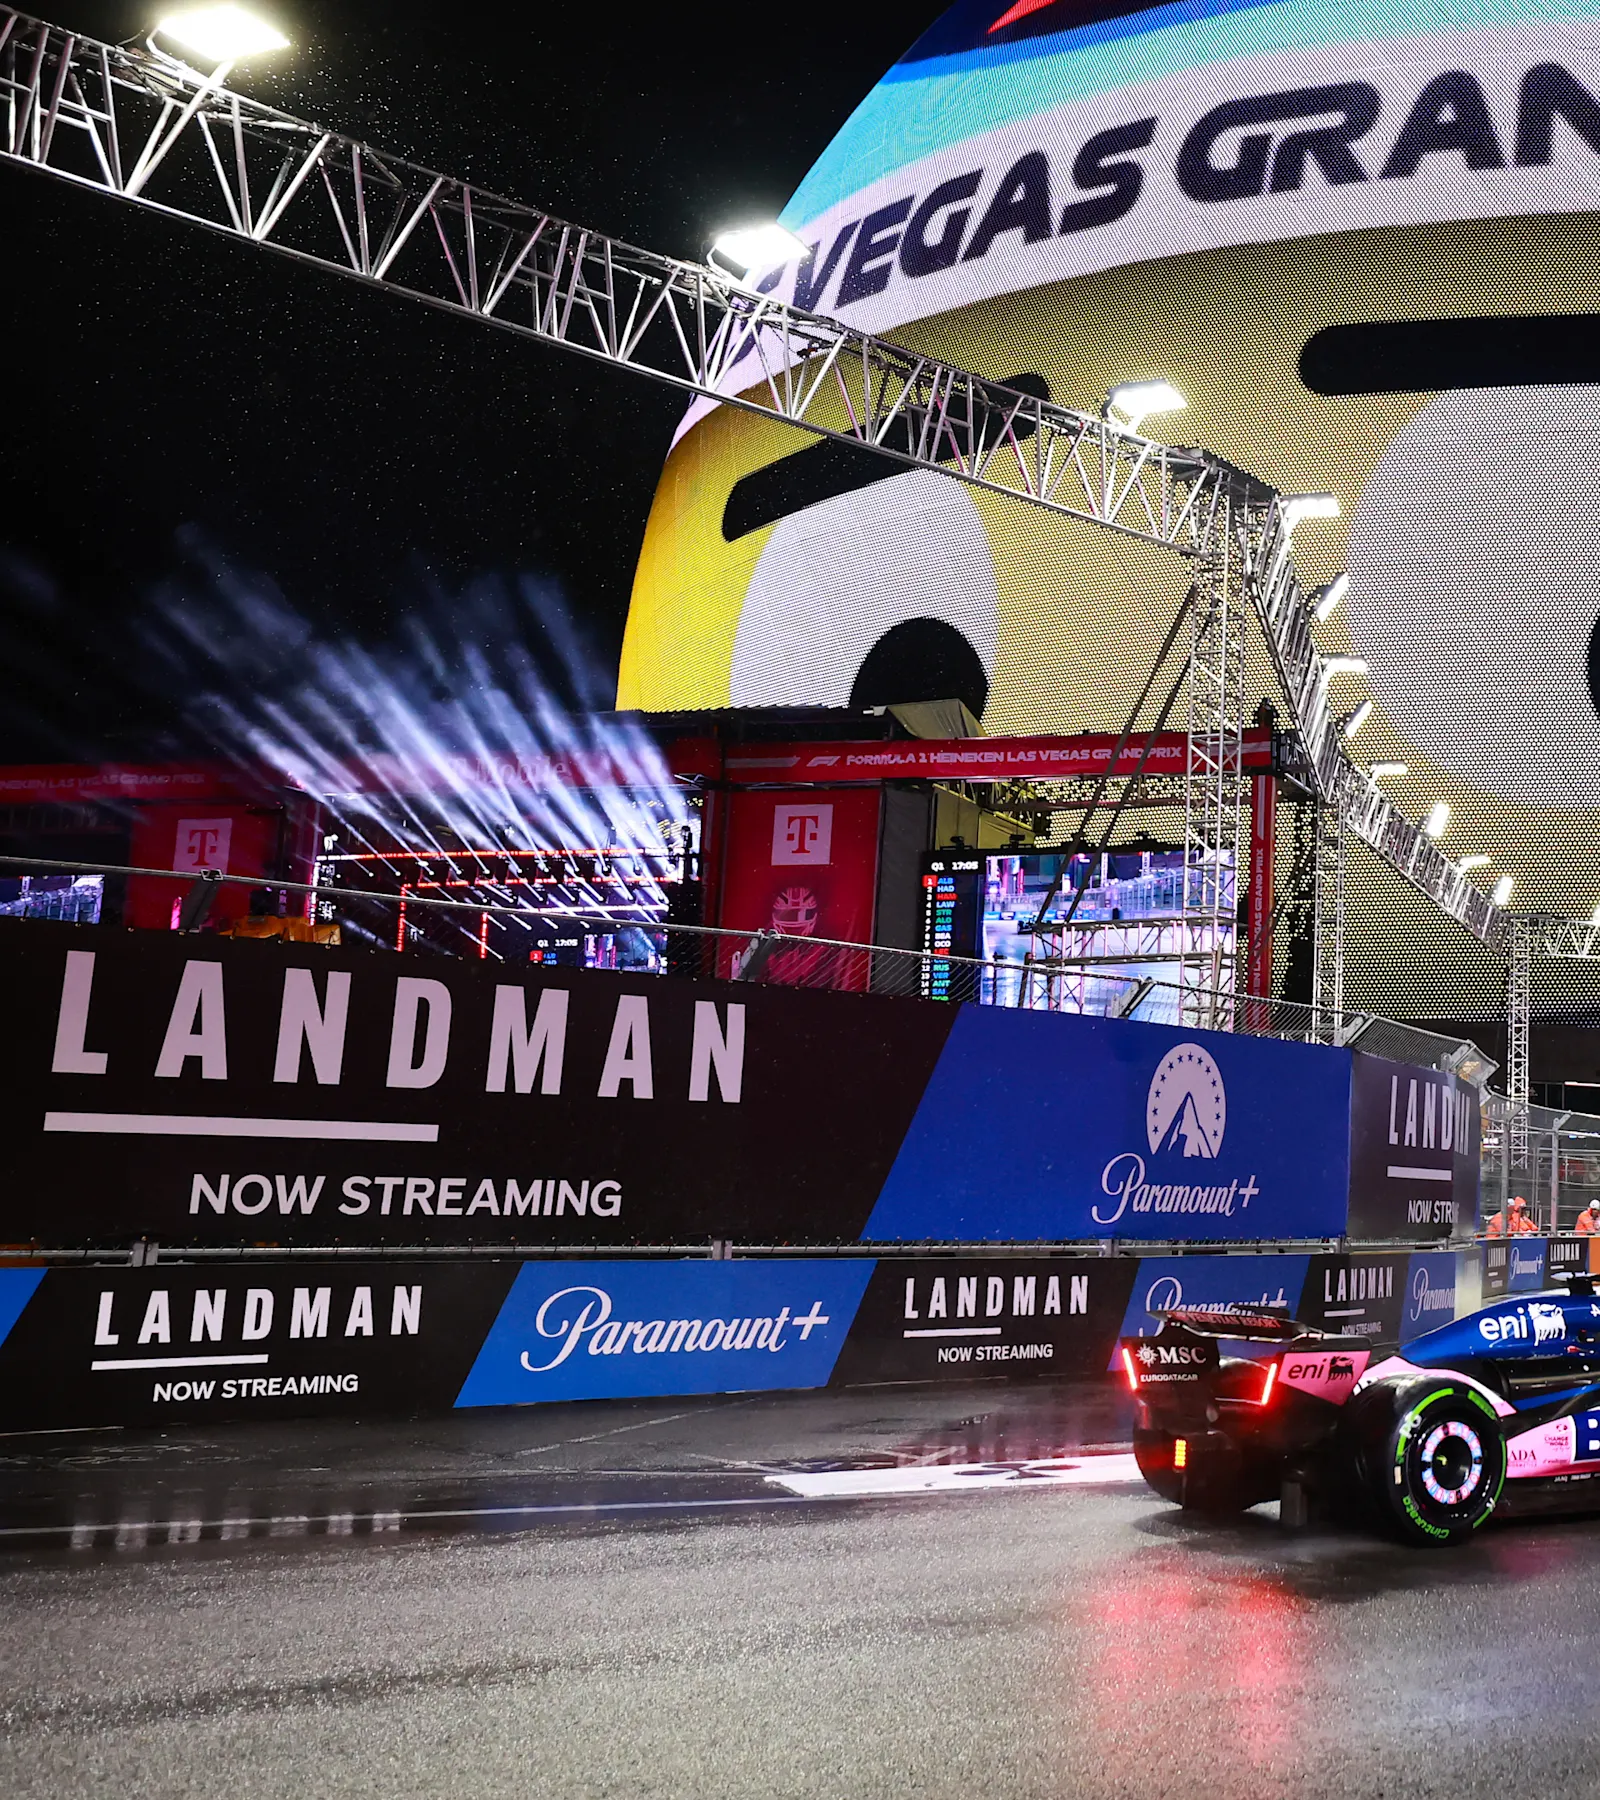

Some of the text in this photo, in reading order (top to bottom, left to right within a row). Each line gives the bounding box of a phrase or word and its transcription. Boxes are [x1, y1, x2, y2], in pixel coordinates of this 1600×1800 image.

[793, 118, 1156, 313] VEGAS
[846, 753, 915, 765] FORMULA
[919, 753, 928, 763] 1
[929, 752, 1004, 764] HEINEKEN
[1007, 751, 1037, 763] LAS
[1041, 750, 1090, 761] VEGAS
[1147, 747, 1182, 759] PRIX
[49, 778, 75, 789] LAS
[931, 861, 979, 872] Q1 17:05
[935, 924, 952, 932] GAS
[537, 939, 578, 947] Q1 17:05
[934, 940, 951, 948] OCO
[52, 951, 746, 1103] LANDMAN
[190, 1174, 621, 1216] NOW STREAMING
[1092, 1153, 1259, 1223] Paramount+
[1408, 1200, 1432, 1223] NOW
[1325, 1267, 1392, 1302] LANDMAN
[905, 1276, 1088, 1319] LANDMAN
[95, 1286, 422, 1345] LANDMAN
[1479, 1309, 1527, 1341] eni
[521, 1286, 829, 1371] Paramount+
[938, 1344, 1053, 1363] NOW STREAMING
[1159, 1346, 1207, 1364] MSC
[1141, 1374, 1198, 1383] EURODATACAR
[1288, 1358, 1326, 1380] eni
[153, 1374, 358, 1402] NOW STREAMING
